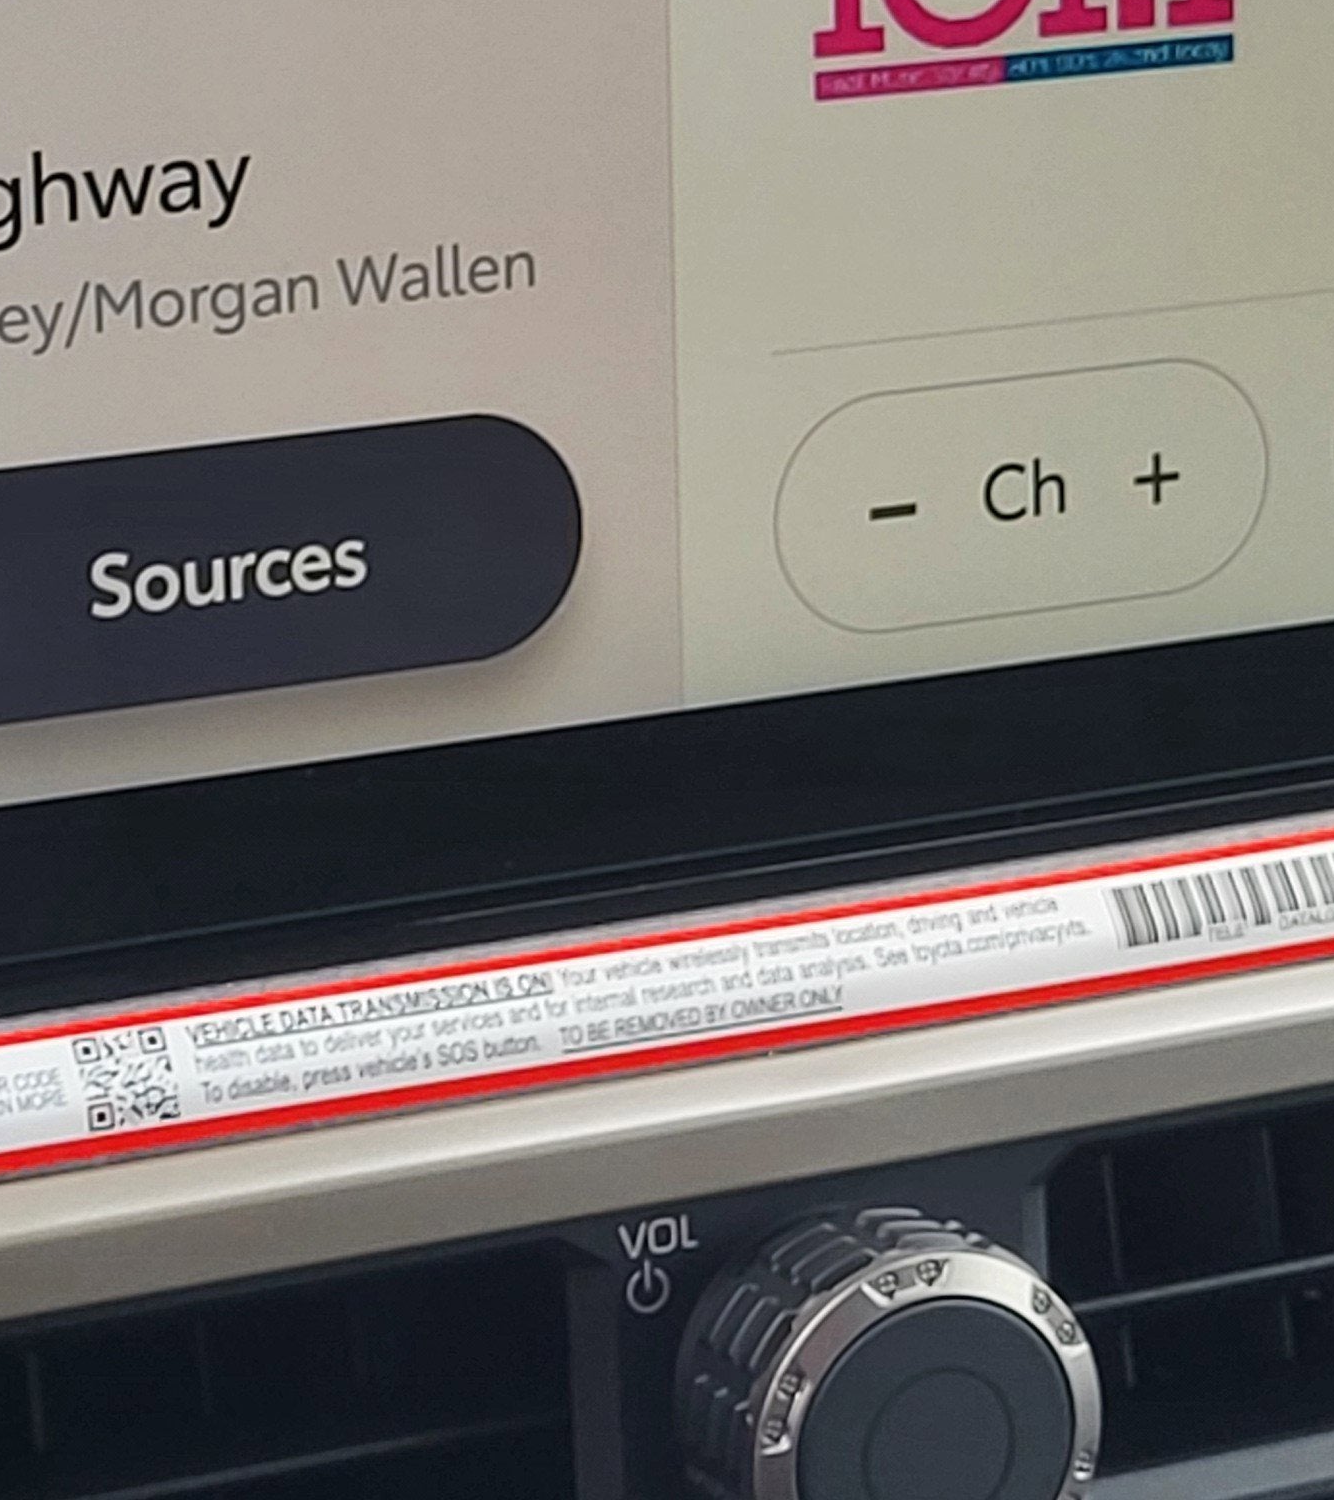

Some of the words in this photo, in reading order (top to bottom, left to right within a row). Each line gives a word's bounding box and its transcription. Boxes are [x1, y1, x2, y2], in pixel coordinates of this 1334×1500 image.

[337, 242, 536, 306] Wallen
[983, 458, 1067, 523] Ch
[89, 539, 366, 619] Sources
[186, 1015, 275, 1044] VEHICLE
[279, 1004, 333, 1031] DATA
[338, 983, 489, 1019] TRANSMISSION
[606, 959, 662, 981] vehicle
[968, 905, 997, 924] and
[1005, 897, 1058, 918] vehicle
[256, 1042, 295, 1064] data
[299, 1038, 317, 1056] to
[324, 1028, 382, 1053] deliver
[389, 1022, 425, 1048] your
[432, 1009, 503, 1037] services
[511, 1002, 541, 1023] and
[544, 997, 567, 1017] for
[640, 976, 716, 1004] research
[722, 969, 753, 991] and
[757, 963, 793, 986] data
[874, 946, 908, 968] See
[201, 1080, 222, 1104] To
[303, 1064, 352, 1090] press
[438, 1041, 478, 1066] SOS
[559, 1025, 582, 1045] TO
[587, 1019, 612, 1041] BE
[615, 1007, 701, 1036] REMOVED
[705, 1003, 726, 1023] BY
[731, 992, 797, 1019] OWNER
[799, 985, 842, 1007] ONLY
[13, 1067, 62, 1091] CODE
[17, 1089, 67, 1112] MORE
[619, 1214, 698, 1259] VOL
